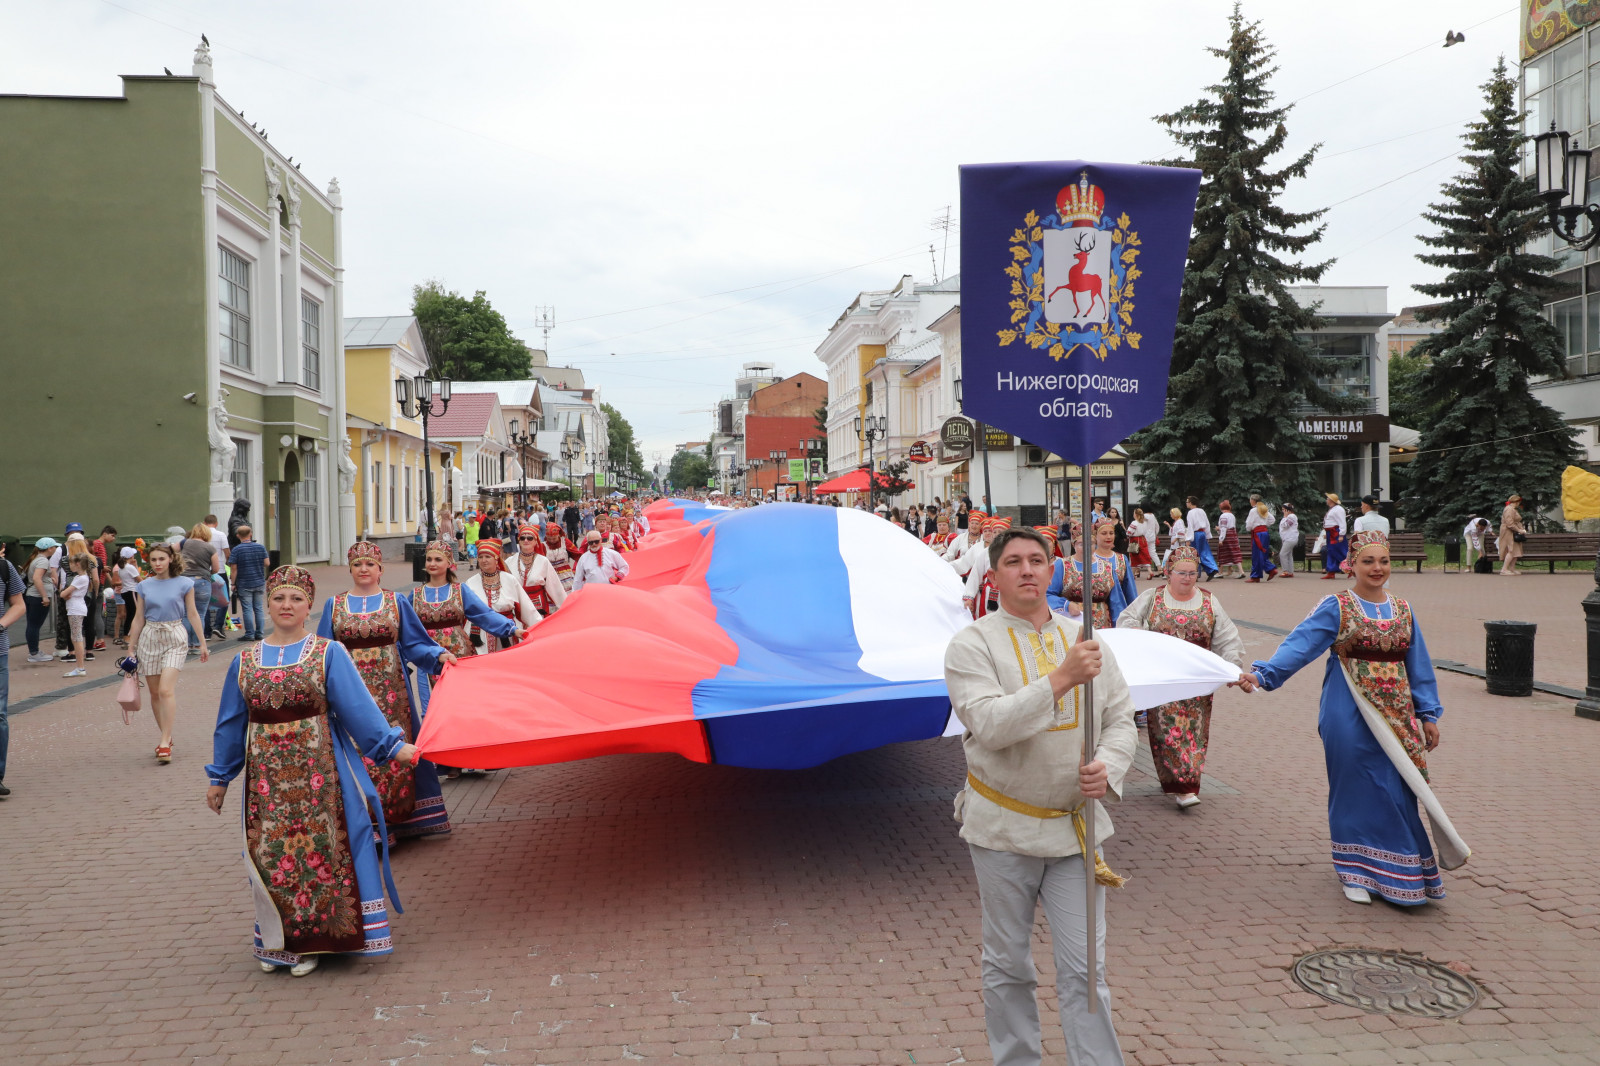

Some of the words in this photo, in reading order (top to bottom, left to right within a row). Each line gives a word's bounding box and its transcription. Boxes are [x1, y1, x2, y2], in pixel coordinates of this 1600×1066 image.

[997, 371, 1139, 394] Нижегородская
[1039, 397, 1113, 419] область
[946, 423, 969, 437] ЛЕПИ
[1295, 420, 1363, 433] ЛЬМЕННАЯ
